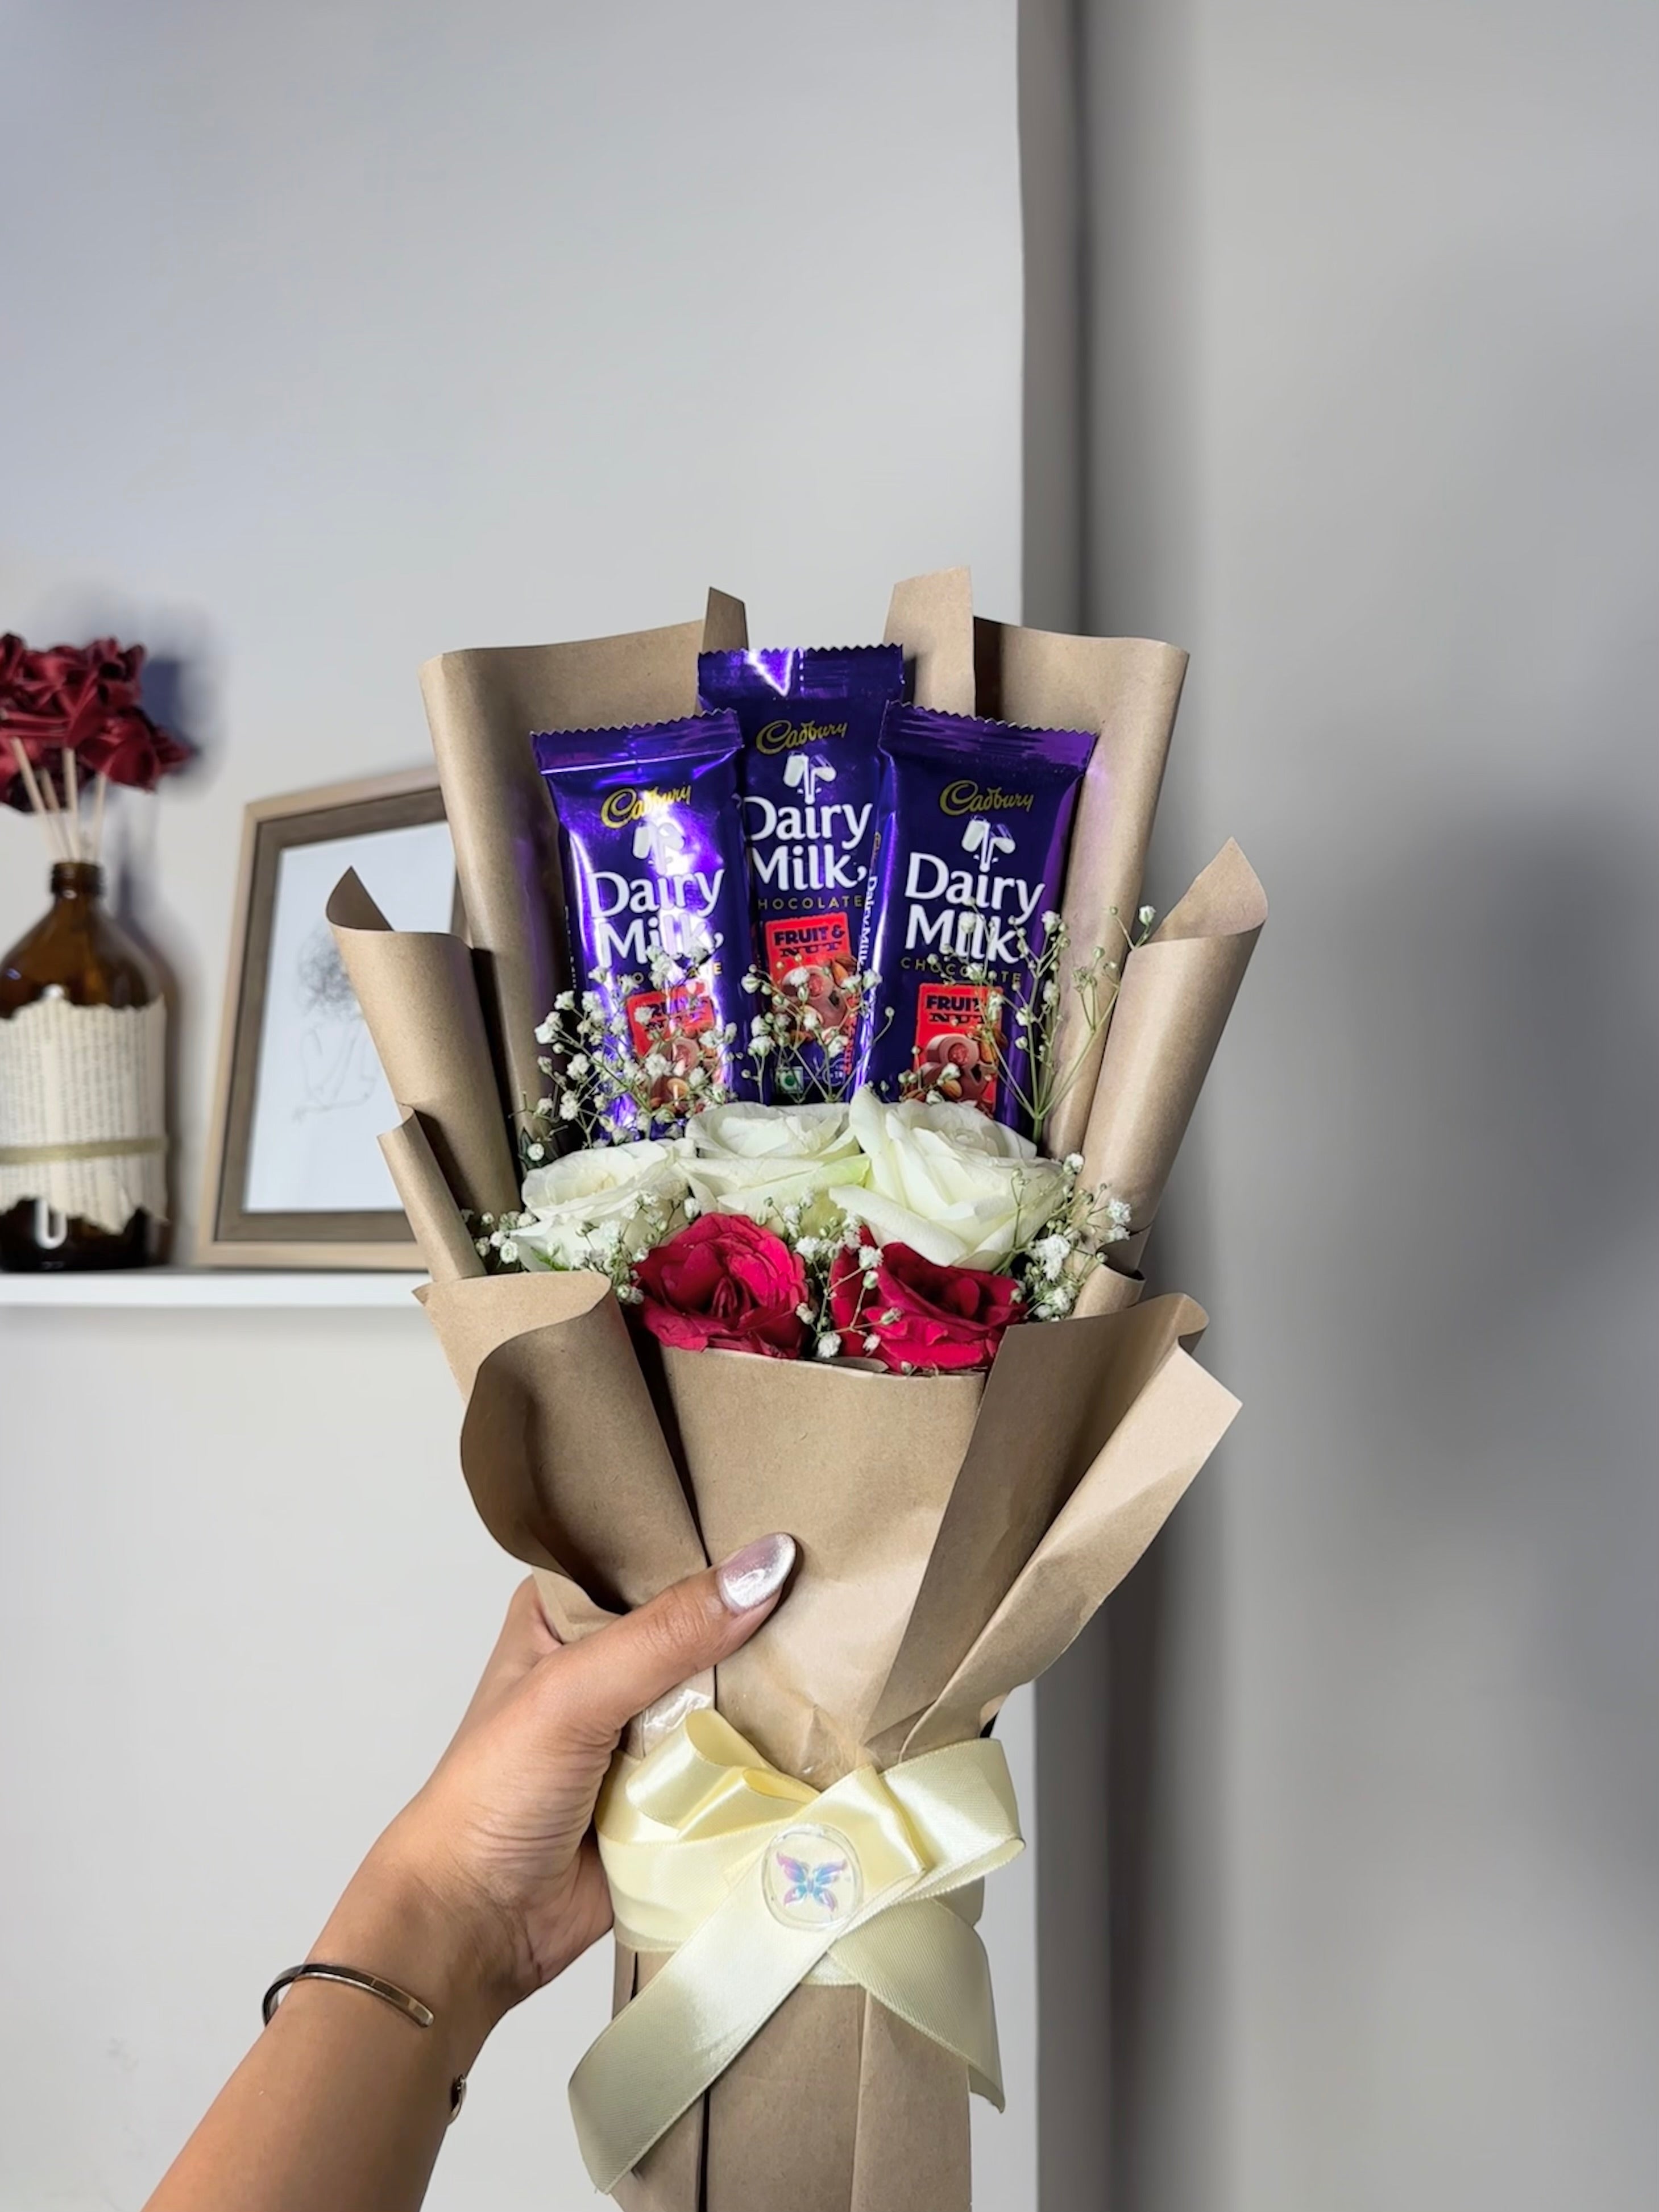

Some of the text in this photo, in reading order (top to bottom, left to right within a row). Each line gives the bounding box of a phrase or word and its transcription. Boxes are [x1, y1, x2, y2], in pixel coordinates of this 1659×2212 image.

[756, 719, 848, 755] Cadbury
[940, 780, 1034, 816] Cadbury
[743, 796, 873, 850] Dairy
[752, 844, 868, 890] Milk
[588, 868, 725, 918] Dairy
[758, 894, 863, 910] HOCOLATE
[905, 852, 1046, 926] Dairy
[774, 924, 845, 946] FRUIT &
[779, 941, 843, 958] NUT
[905, 904, 1019, 964] Milk
